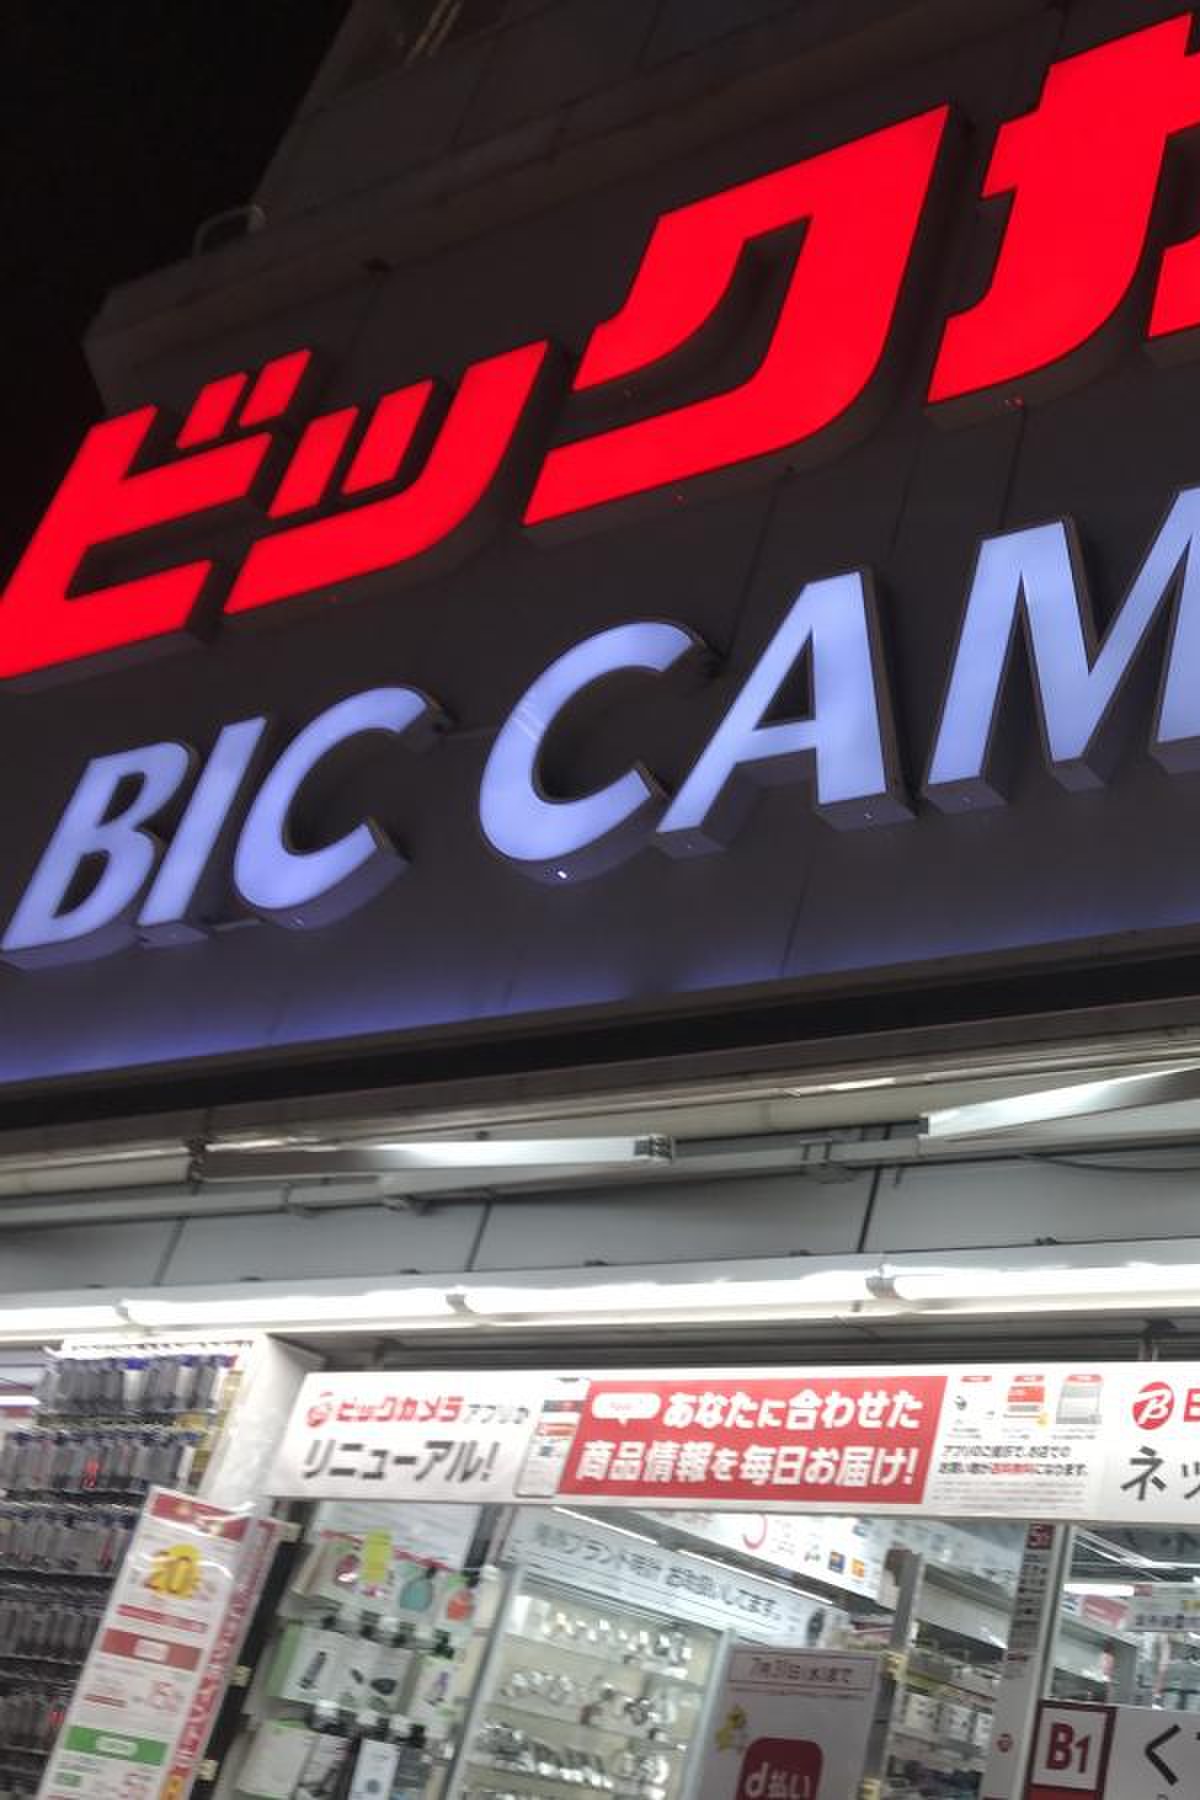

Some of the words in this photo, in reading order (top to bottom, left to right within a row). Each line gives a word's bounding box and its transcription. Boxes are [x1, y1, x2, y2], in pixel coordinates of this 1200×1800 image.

[1, 687, 430, 951] BIC
[662, 1390, 924, 1430] あなたに合わせた
[303, 1439, 500, 1482] リニューアル!
[575, 1441, 920, 1487] 商品情報を毎日お届け!
[1046, 1723, 1092, 1774] B1
